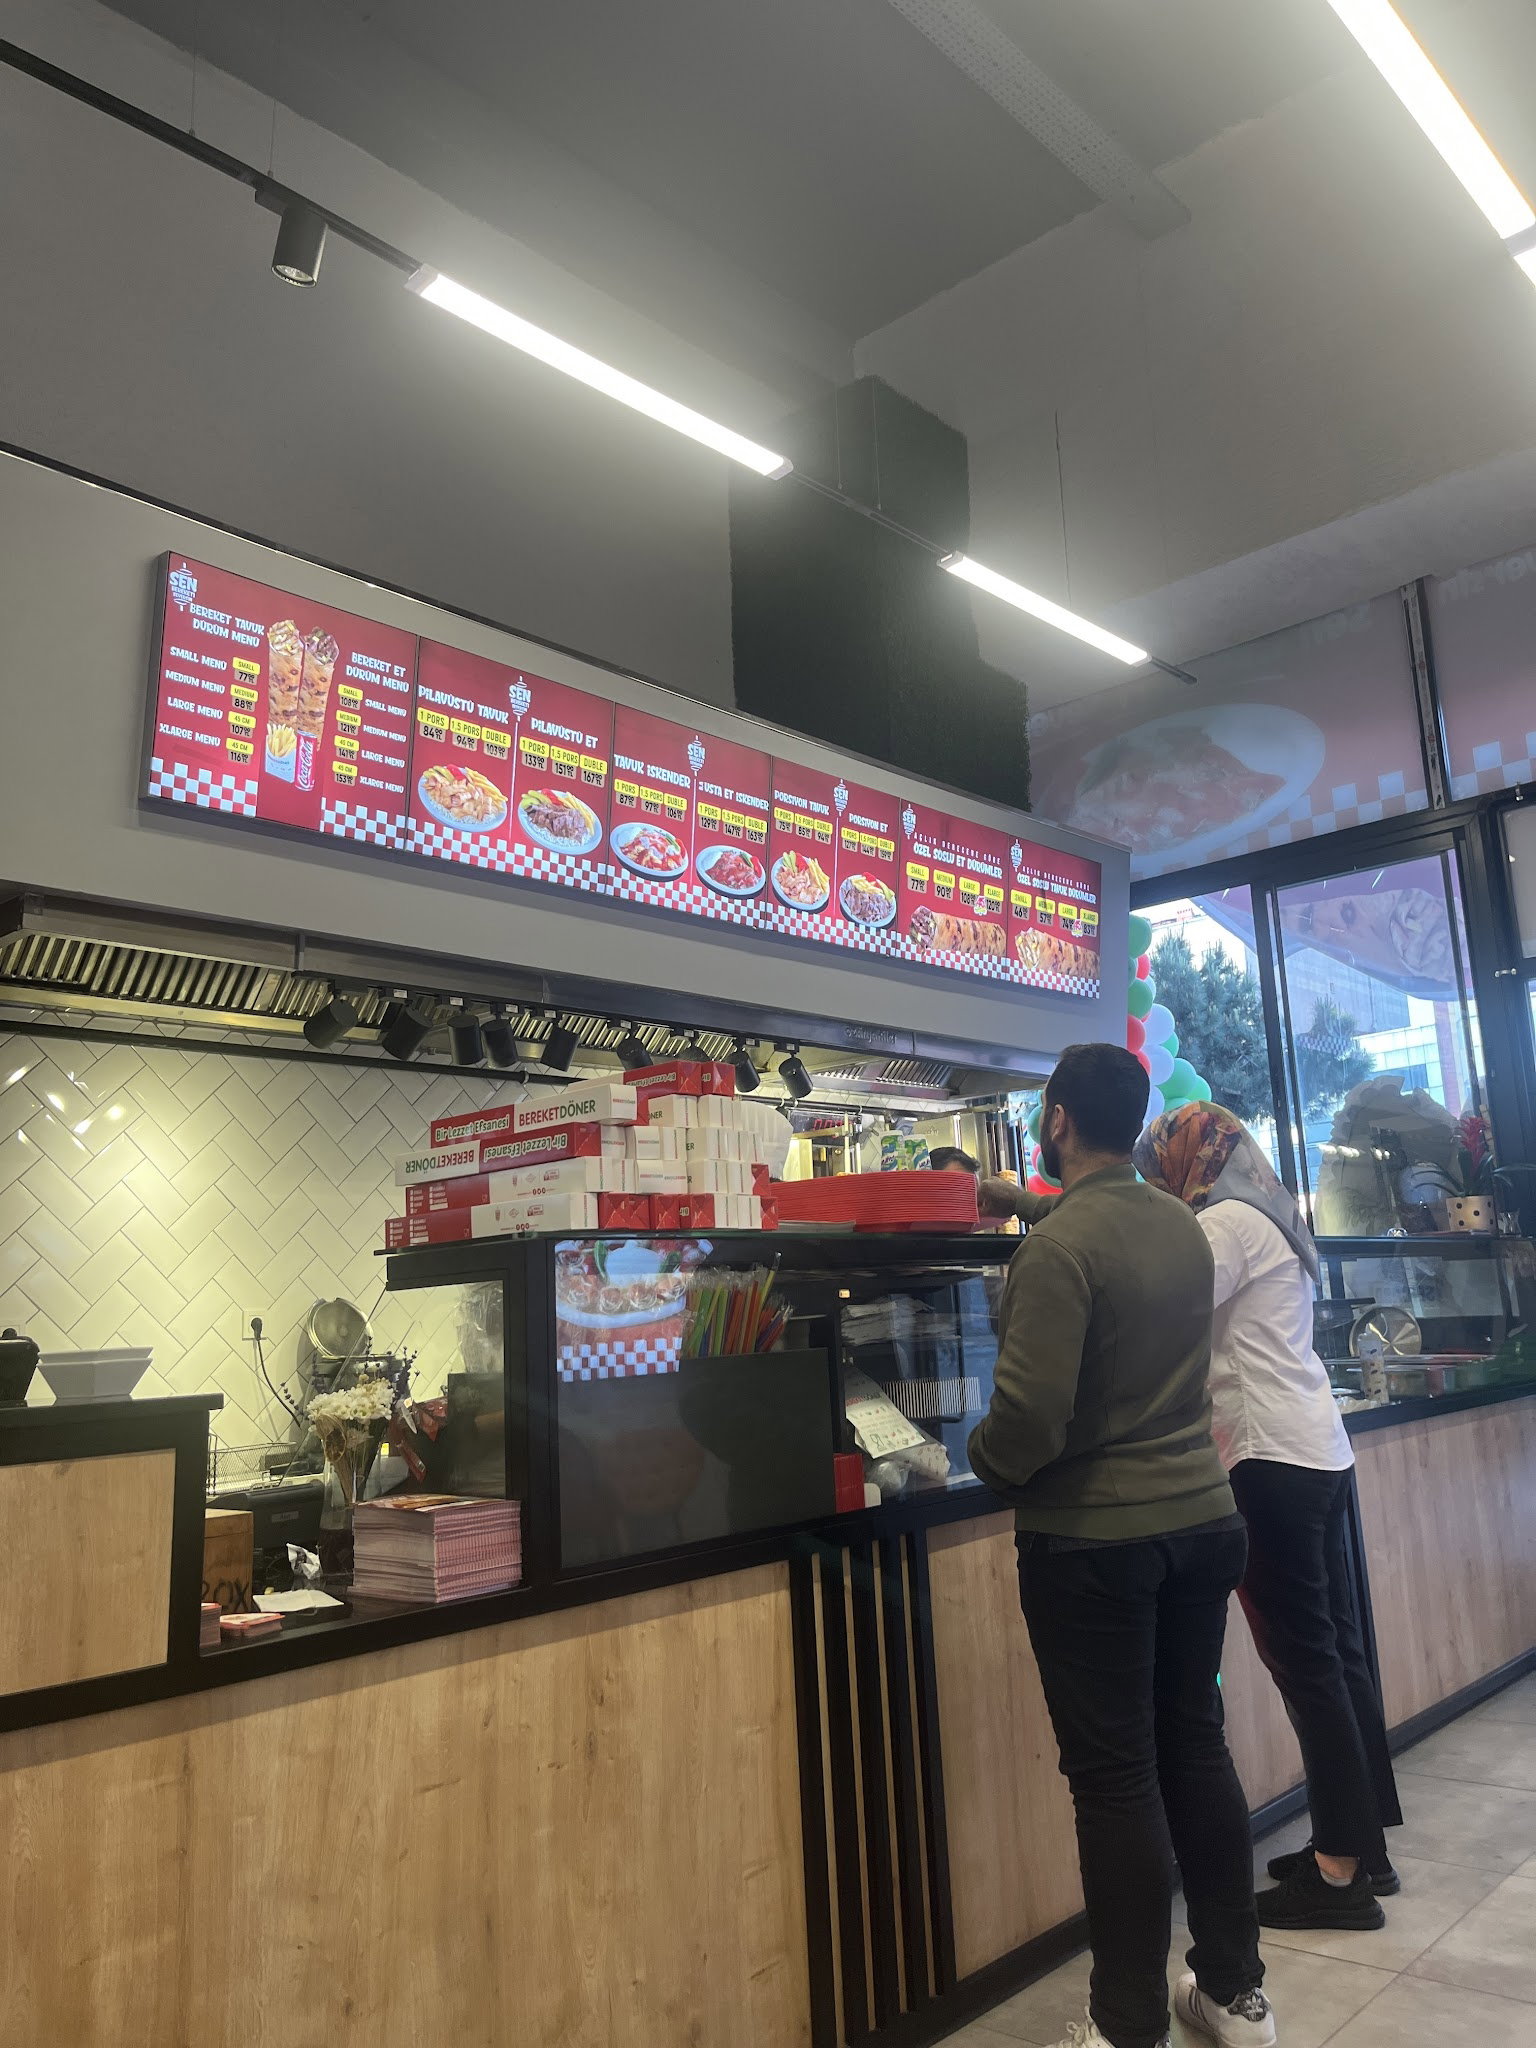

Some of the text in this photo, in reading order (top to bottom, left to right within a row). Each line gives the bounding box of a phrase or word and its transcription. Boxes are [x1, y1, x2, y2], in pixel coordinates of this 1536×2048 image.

[170, 572, 197, 592] SEN
[190, 603, 264, 635] BEREKET TAVUK
[170, 646, 199, 662] SMALL
[238, 662, 254, 671] SMALL
[352, 652, 406, 677] BEREKET ET
[165, 670, 199, 686] MEDIUM
[234, 689, 254, 698] MEDIUM
[343, 688, 358, 697] SMALL
[509, 685, 531, 702] SEN
[168, 697, 195, 712] LARGE
[365, 699, 386, 712] SMALL
[340, 714, 358, 723] MEDIUM
[427, 713, 444, 726] PORS
[478, 704, 508, 724] TAVUK
[159, 723, 192, 739] XLARGE
[363, 725, 387, 738] MEDIUM
[464, 725, 479, 737] PORS
[486, 731, 506, 744] DUBLE
[529, 742, 545, 754] PORS
[586, 735, 598, 748] ET
[362, 750, 383, 763] LARGE
[563, 752, 578, 764] PORS
[688, 744, 705, 759] SEN
[584, 758, 603, 771] DUBLE
[614, 754, 644, 774] TAVUK
[360, 776, 384, 788] XLARGE
[622, 784, 635, 794] PORS
[725, 788, 734, 800] ET
[834, 787, 848, 800] SEN
[650, 792, 662, 801] PORS
[668, 797, 683, 807] DUBLE
[705, 807, 717, 817] PORS
[809, 800, 829, 815] TAVUK
[732, 815, 743, 824] PORS
[780, 811, 791, 820] PORS
[903, 811, 916, 824] SEN
[749, 819, 763, 830] DUBLE
[880, 823, 888, 832] ET
[846, 831, 857, 839] PORS
[933, 849, 954, 864] SOSLU
[956, 855, 965, 867] ET
[1011, 846, 1022, 857] SEN
[911, 866, 924, 876] SMALL
[937, 874, 952, 884] MEDIUM
[964, 881, 975, 891] LARGE
[1051, 882, 1067, 896] TAVUK
[1015, 894, 1026, 903] SMALL
[1063, 907, 1073, 915] LARGE
[436, 1114, 509, 1141] Bir Lezzet Efsanesi
[484, 1133, 567, 1161] Bir Lezzet Efsanesi
